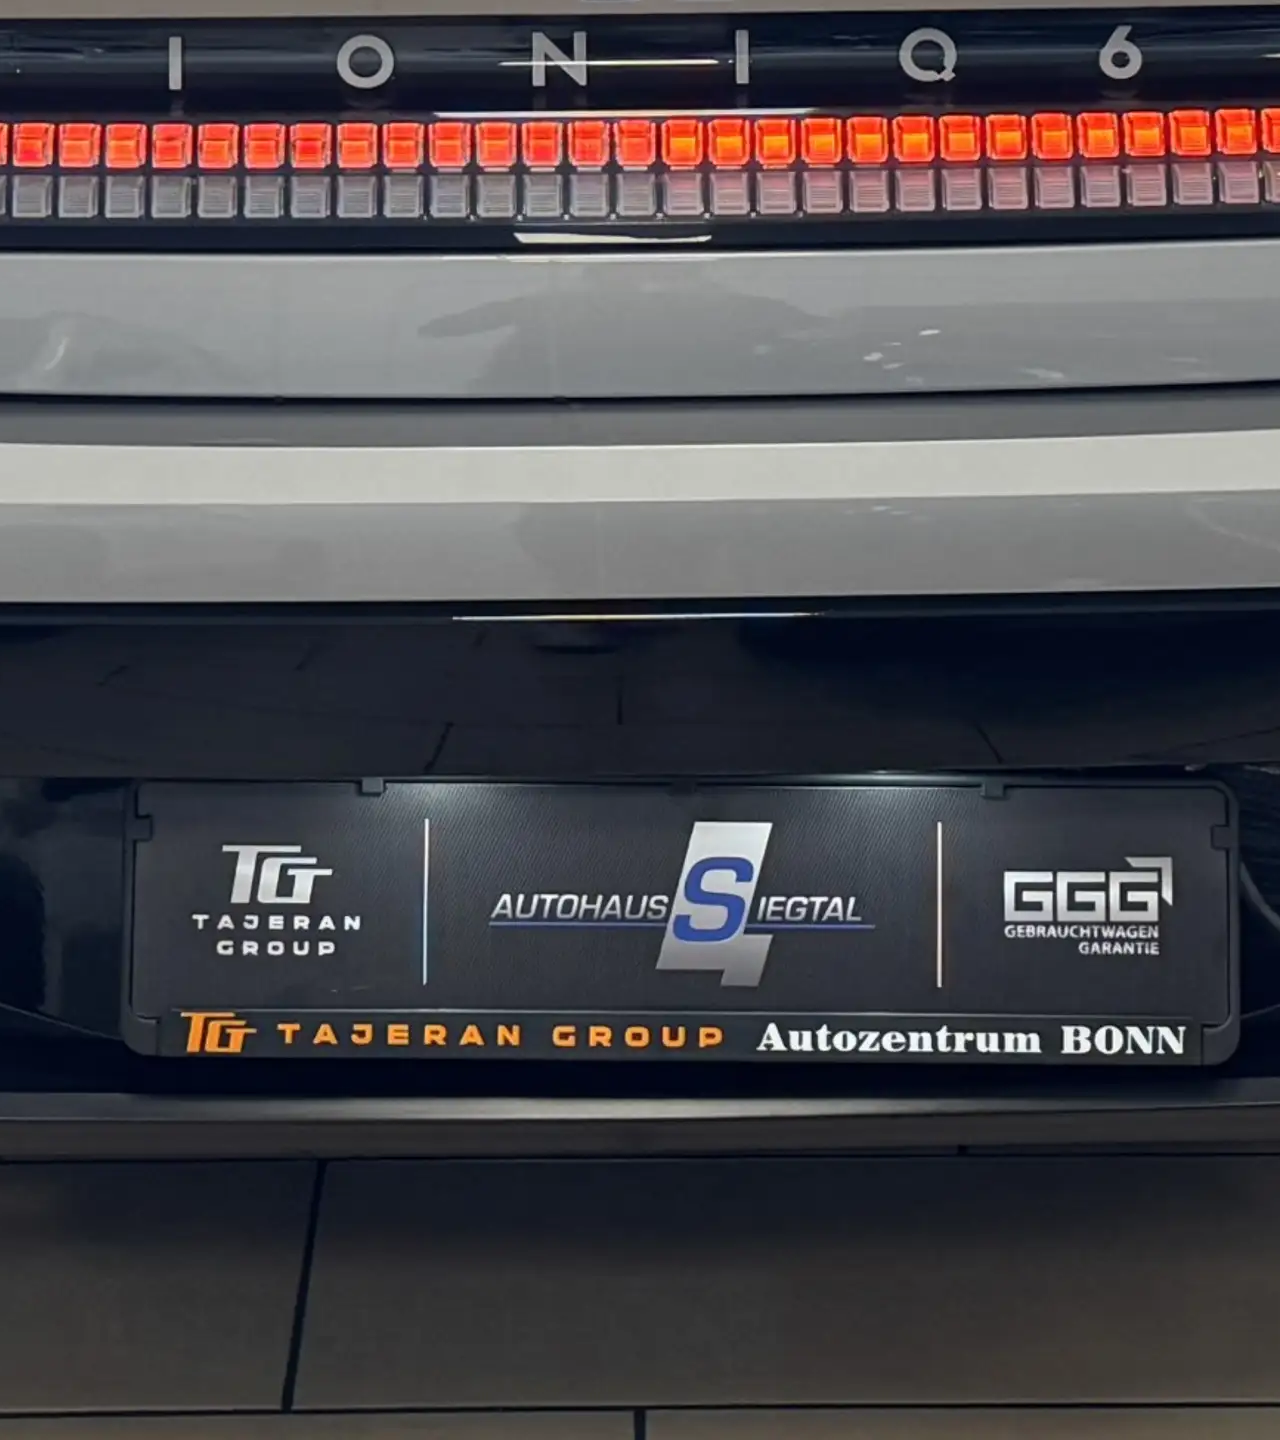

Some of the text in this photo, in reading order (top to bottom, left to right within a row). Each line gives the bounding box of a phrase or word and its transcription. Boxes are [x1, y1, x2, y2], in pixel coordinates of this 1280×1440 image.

[169, 25, 1143, 90] IONIQ 6
[490, 893, 669, 921] AUTOHAUS
[1004, 871, 1159, 922] GGG
[192, 913, 361, 931] TAJERAN
[1004, 924, 1160, 939] GEBRAUCHTWAGEN
[216, 940, 336, 956] GROUP
[1078, 940, 1161, 956] GARANTIE
[277, 1022, 520, 1047] TAJERAN
[552, 1025, 724, 1048] GROUP
[756, 1021, 1043, 1054] Autozentrum
[1060, 1024, 1187, 1055] BONN
